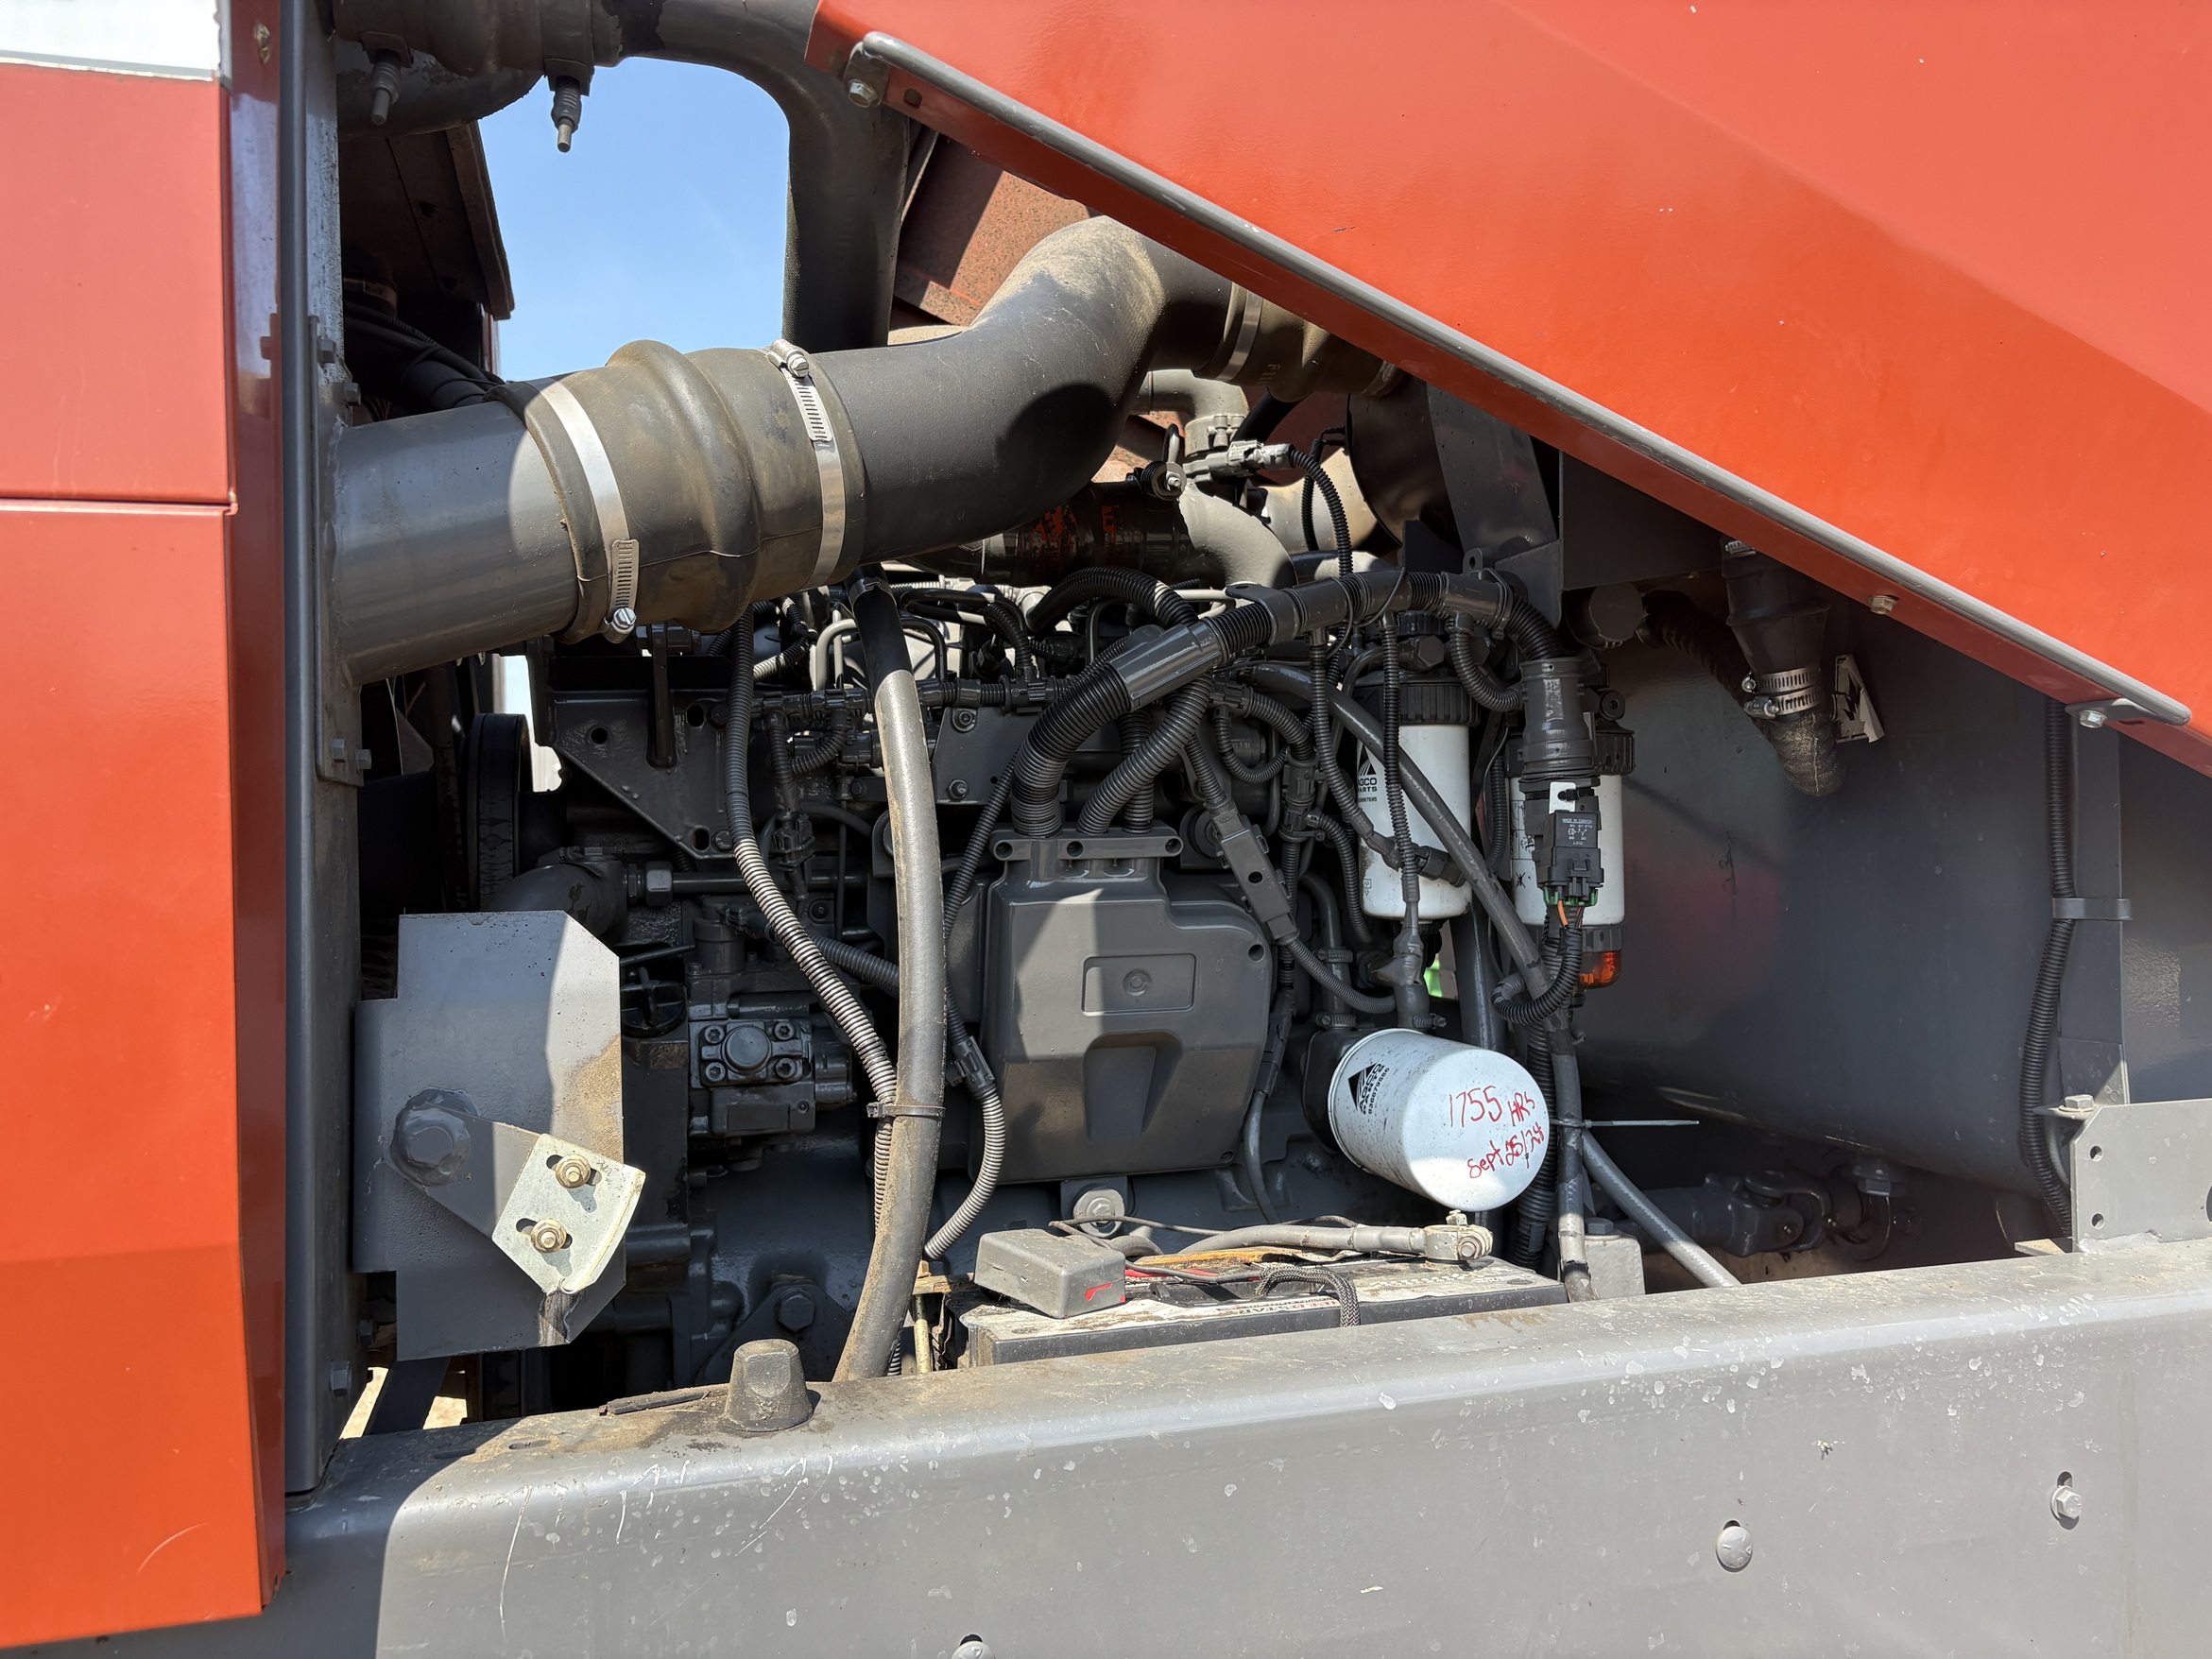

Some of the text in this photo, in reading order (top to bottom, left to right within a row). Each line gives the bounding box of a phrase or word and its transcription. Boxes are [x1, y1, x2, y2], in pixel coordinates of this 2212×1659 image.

[1360, 1063, 1381, 1112] AGCO
[1363, 1065, 1385, 1115] PARTS
[1449, 1085, 1503, 1128] 1755
